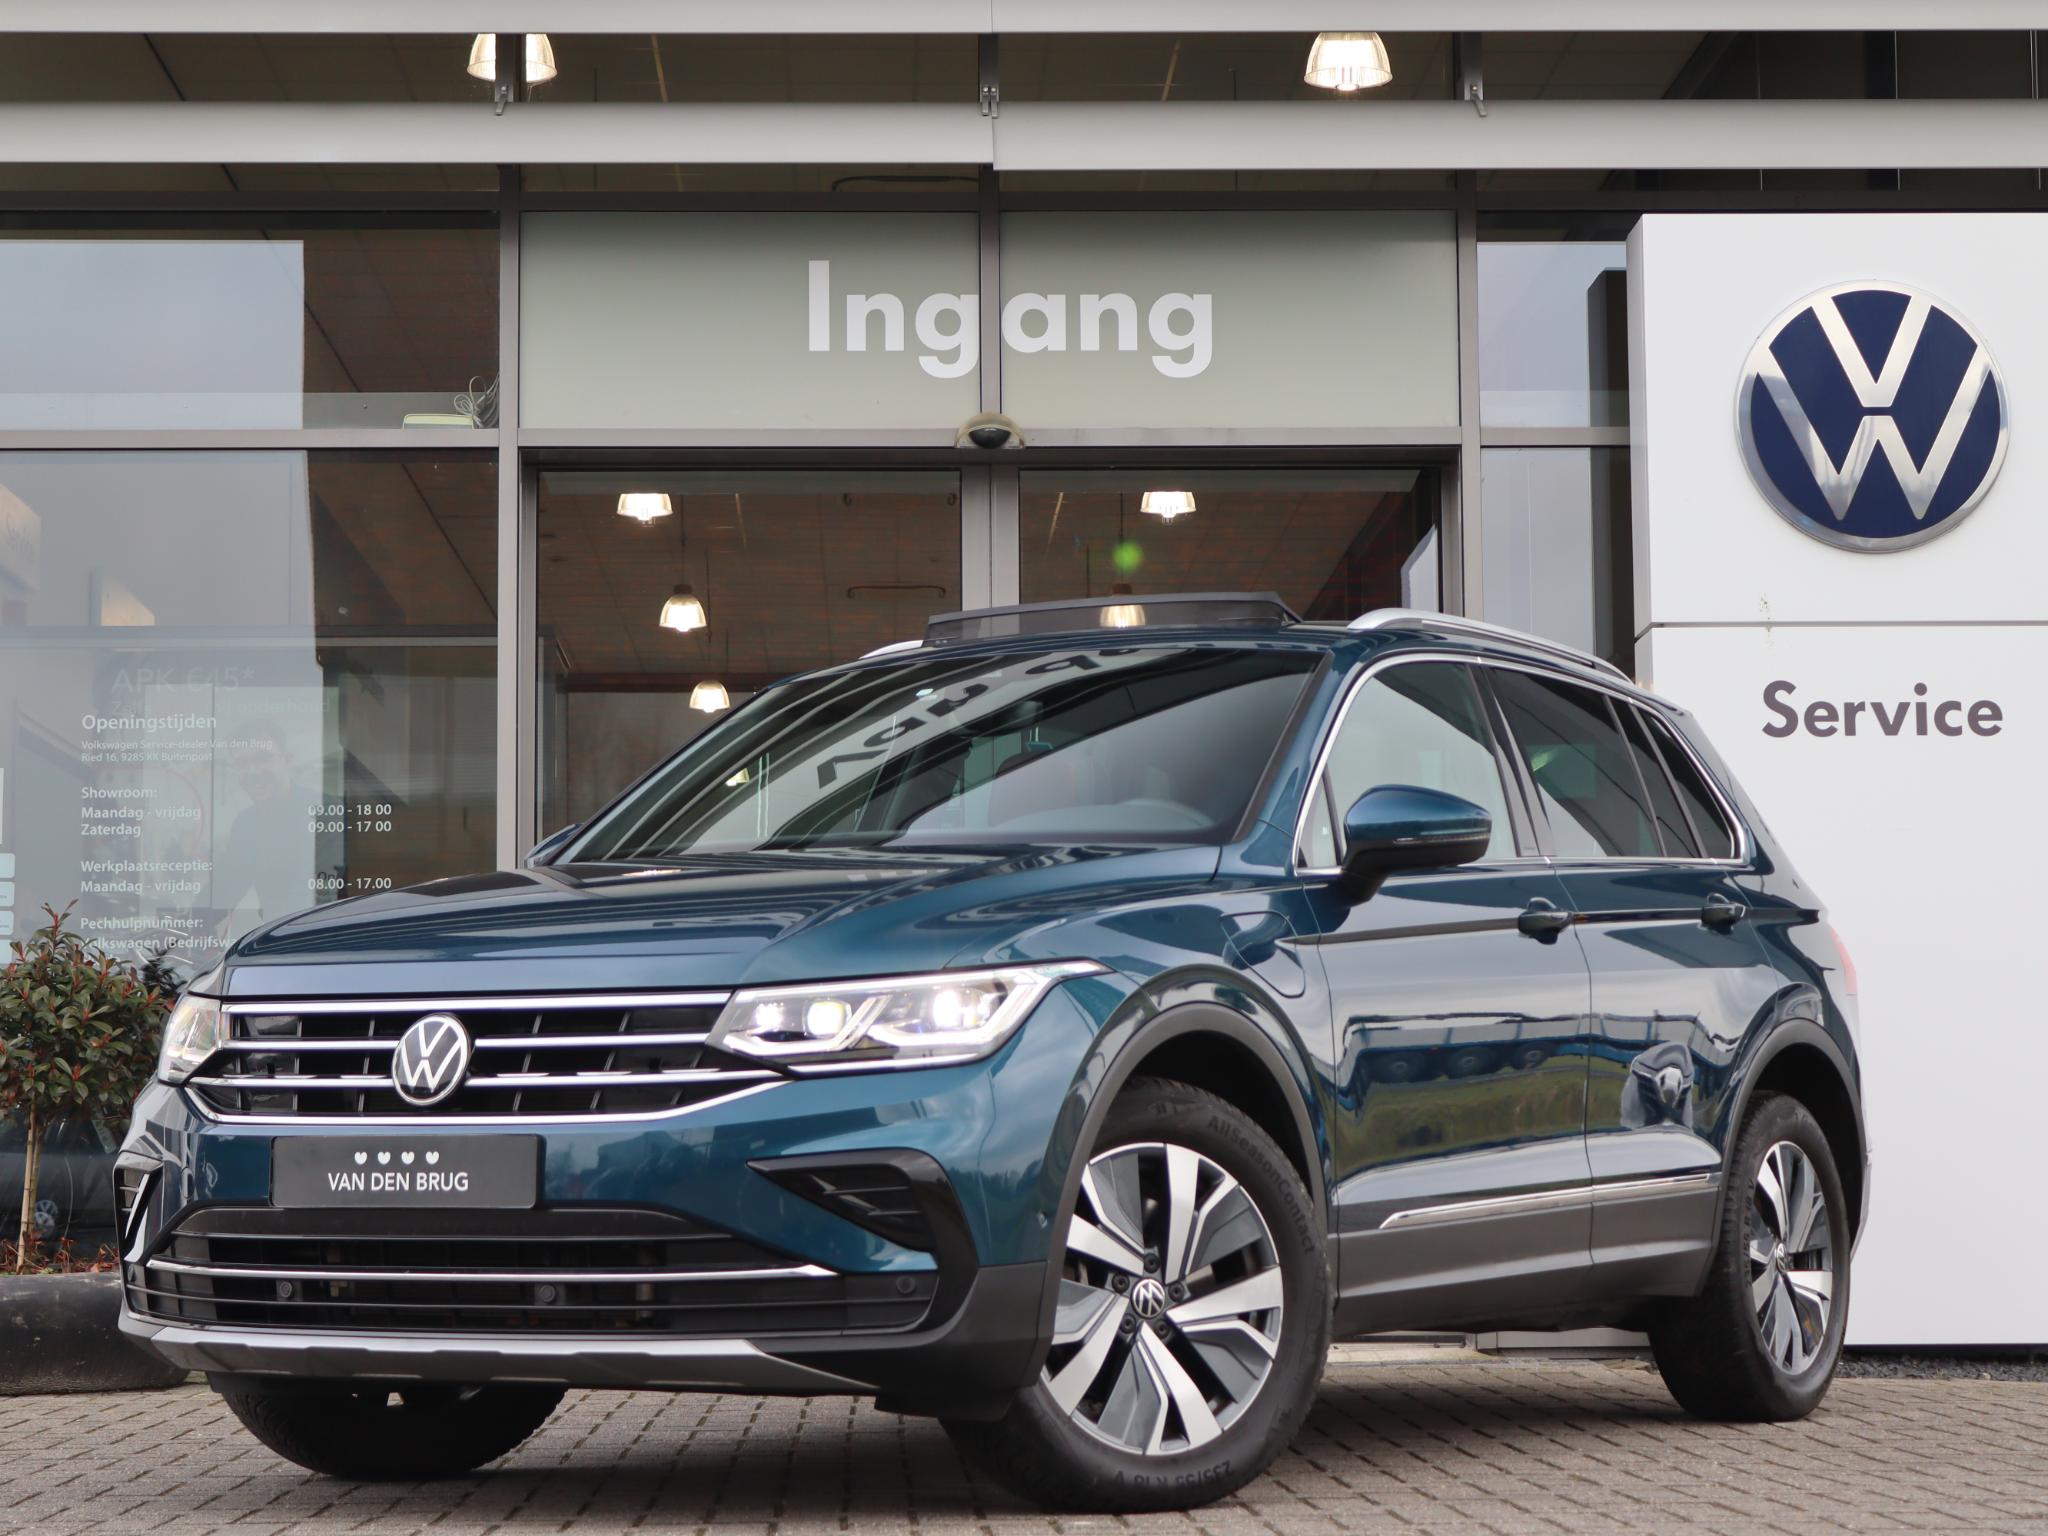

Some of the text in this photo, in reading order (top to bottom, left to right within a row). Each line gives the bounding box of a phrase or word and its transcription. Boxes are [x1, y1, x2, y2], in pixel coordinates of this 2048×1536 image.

[808, 259, 1213, 379] Ingang
[1762, 680, 2003, 738] Service
[81, 714, 217, 733] Openingstijden
[81, 740, 138, 751] Volkswagen
[81, 752, 103, 762] Ried
[81, 786, 158, 799] Showroom:
[81, 807, 144, 820] Maandag
[155, 806, 202, 820] vrijdag
[307, 804, 344, 816] 09.00
[81, 823, 142, 837] Zaterdag
[307, 821, 344, 833] 09.00
[81, 860, 214, 874] Werkplaatsreceptie:
[81, 881, 144, 894] Maandag
[154, 880, 201, 894] vrijdag
[307, 878, 344, 890] 08.00
[356, 877, 392, 889] 17.00
[80, 917, 204, 931] Pechhulpnummer:
[328, 1172, 469, 1191] VAN DEN BRUG
